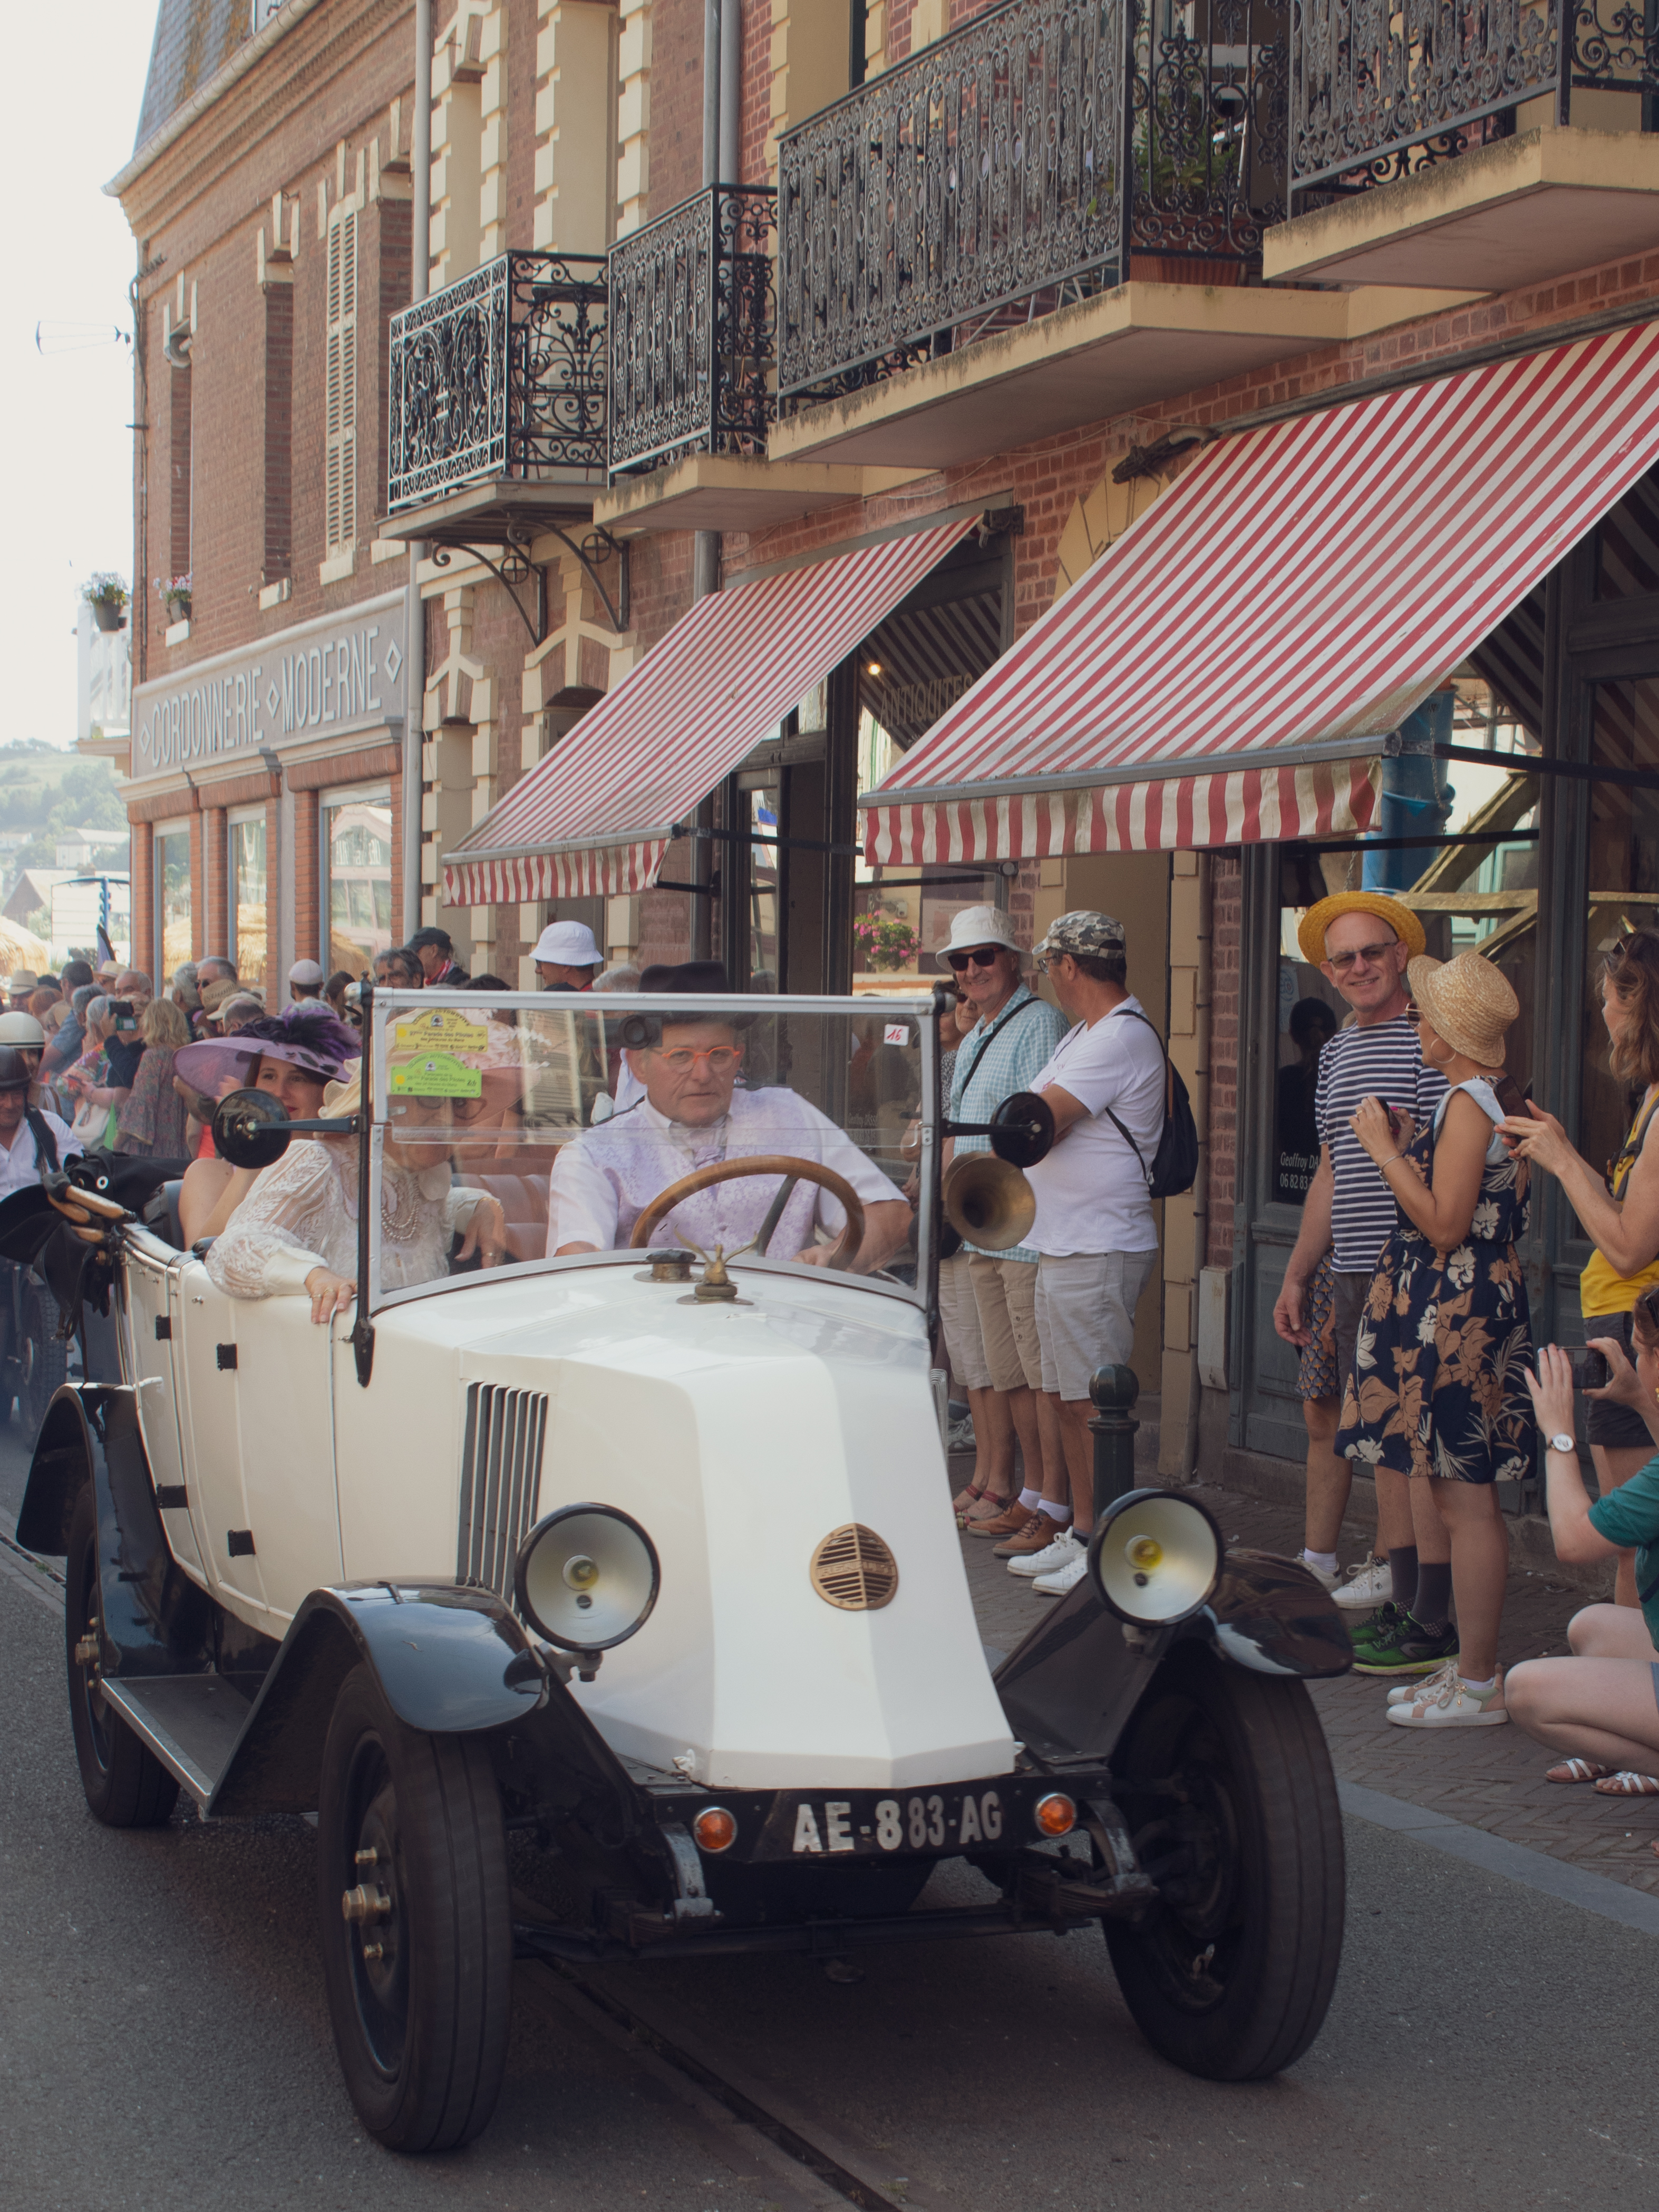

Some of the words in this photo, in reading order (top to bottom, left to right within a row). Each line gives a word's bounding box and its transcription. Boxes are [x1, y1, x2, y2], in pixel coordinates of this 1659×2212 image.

[152, 666, 264, 767] CORDONNERIE
[282, 626, 382, 733] MODERNE
[886, 1028, 903, 1041] 16
[1280, 1151, 1308, 1172] Geoffroy
[1280, 1173, 1288, 1188] 06
[1289, 1174, 1298, 1189] 82
[1299, 1175, 1308, 1190] 83
[792, 1791, 1003, 1852] AE-883-AG
